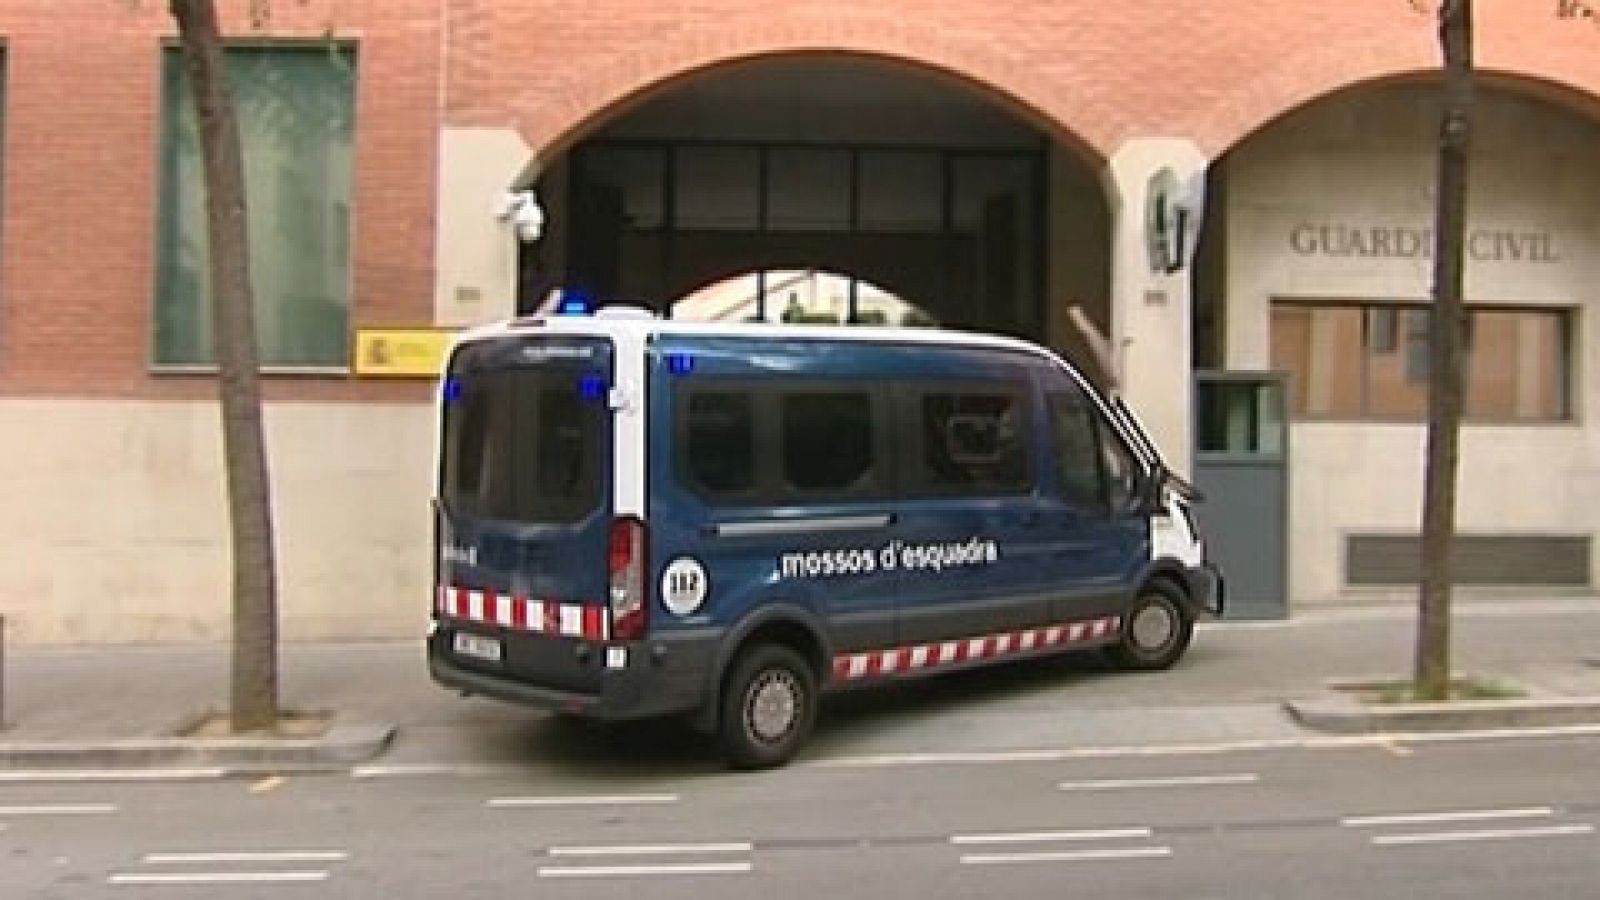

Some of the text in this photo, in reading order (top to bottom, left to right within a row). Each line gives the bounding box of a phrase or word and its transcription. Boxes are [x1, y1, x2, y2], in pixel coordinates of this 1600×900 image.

[1290, 223, 1561, 263] GUARDI CIVIL
[782, 537, 998, 578] mossos d'esquadra
[669, 570, 700, 595] 112
